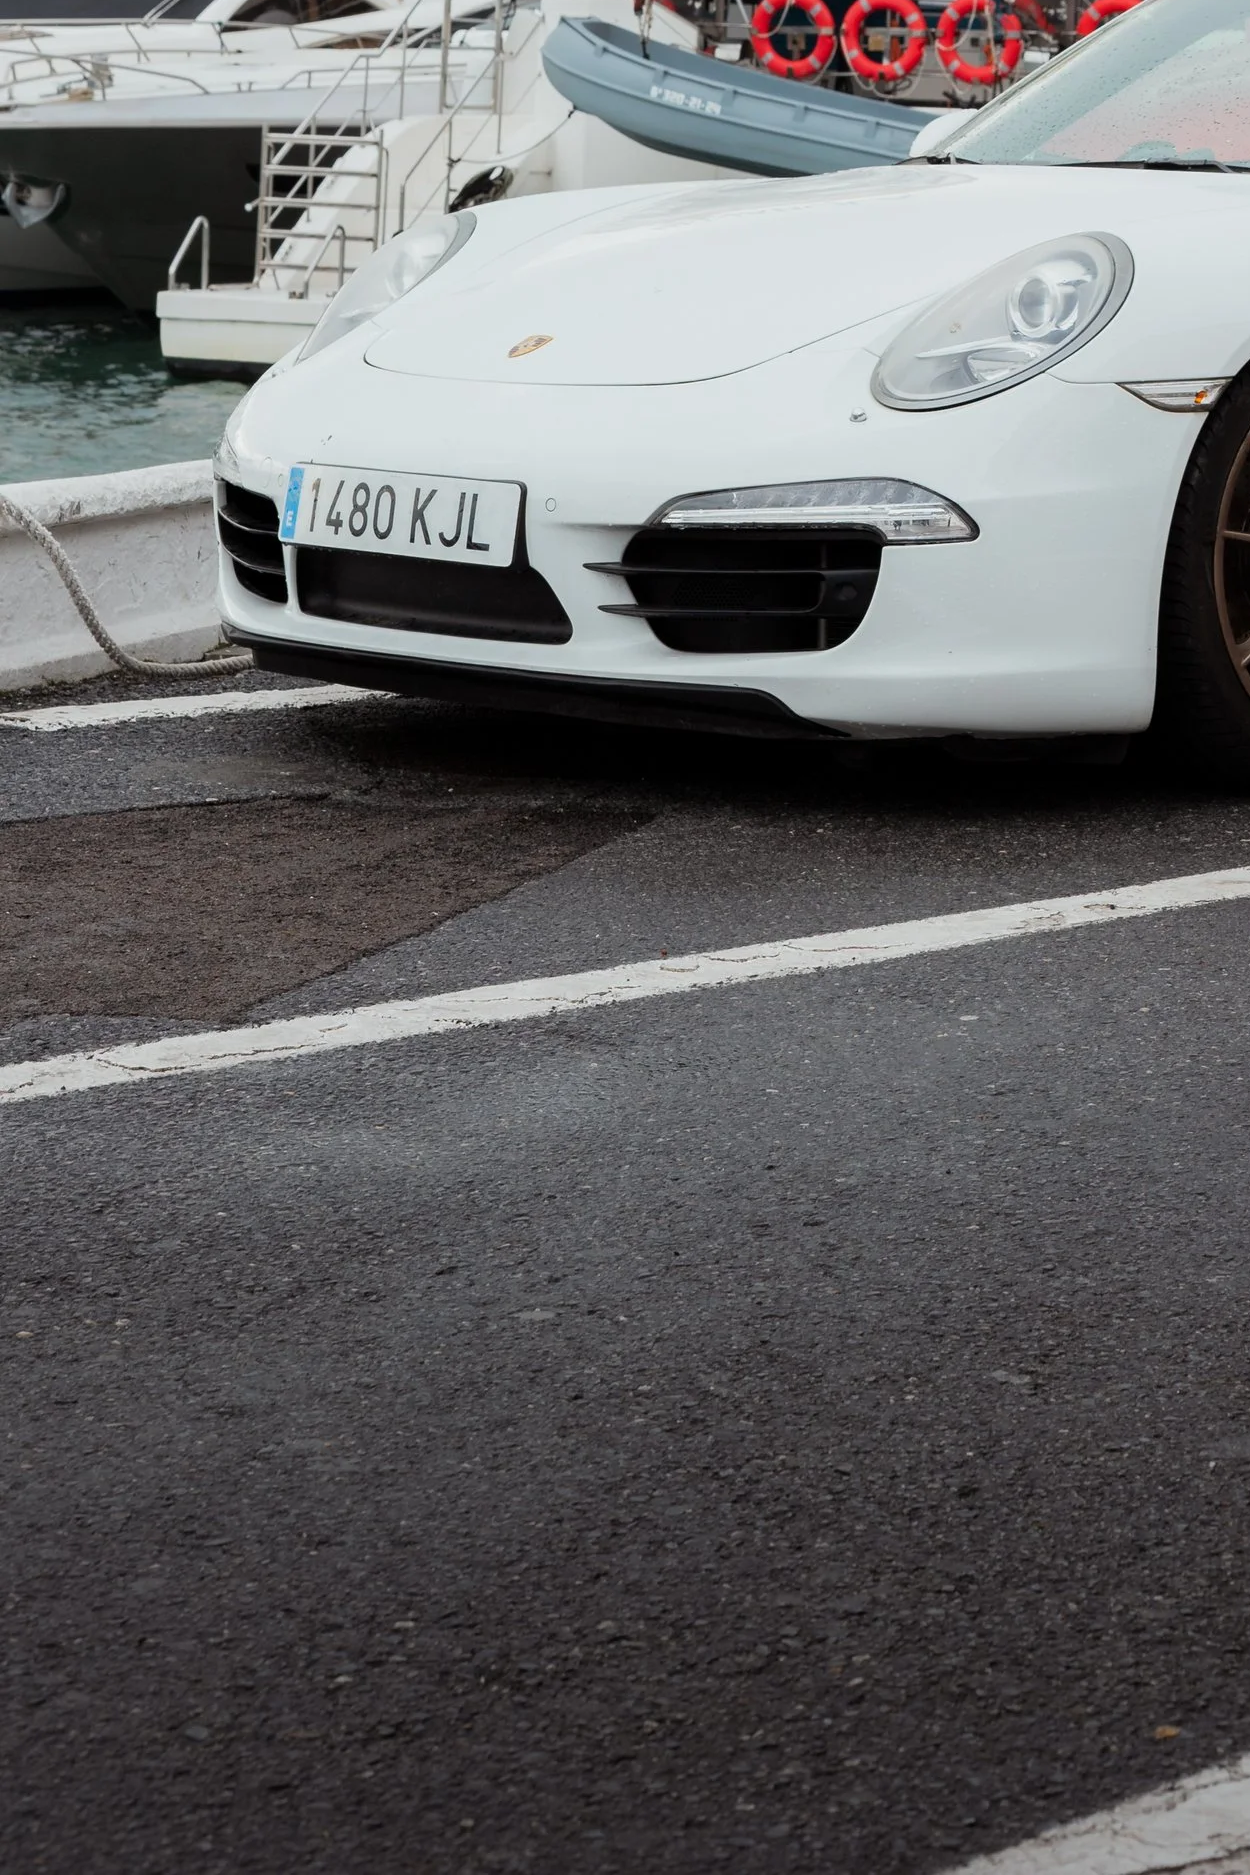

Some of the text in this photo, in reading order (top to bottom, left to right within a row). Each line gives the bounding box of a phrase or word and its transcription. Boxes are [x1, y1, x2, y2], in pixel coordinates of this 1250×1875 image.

[286, 509, 293, 527] E
[309, 477, 490, 552] 1480 KJL
